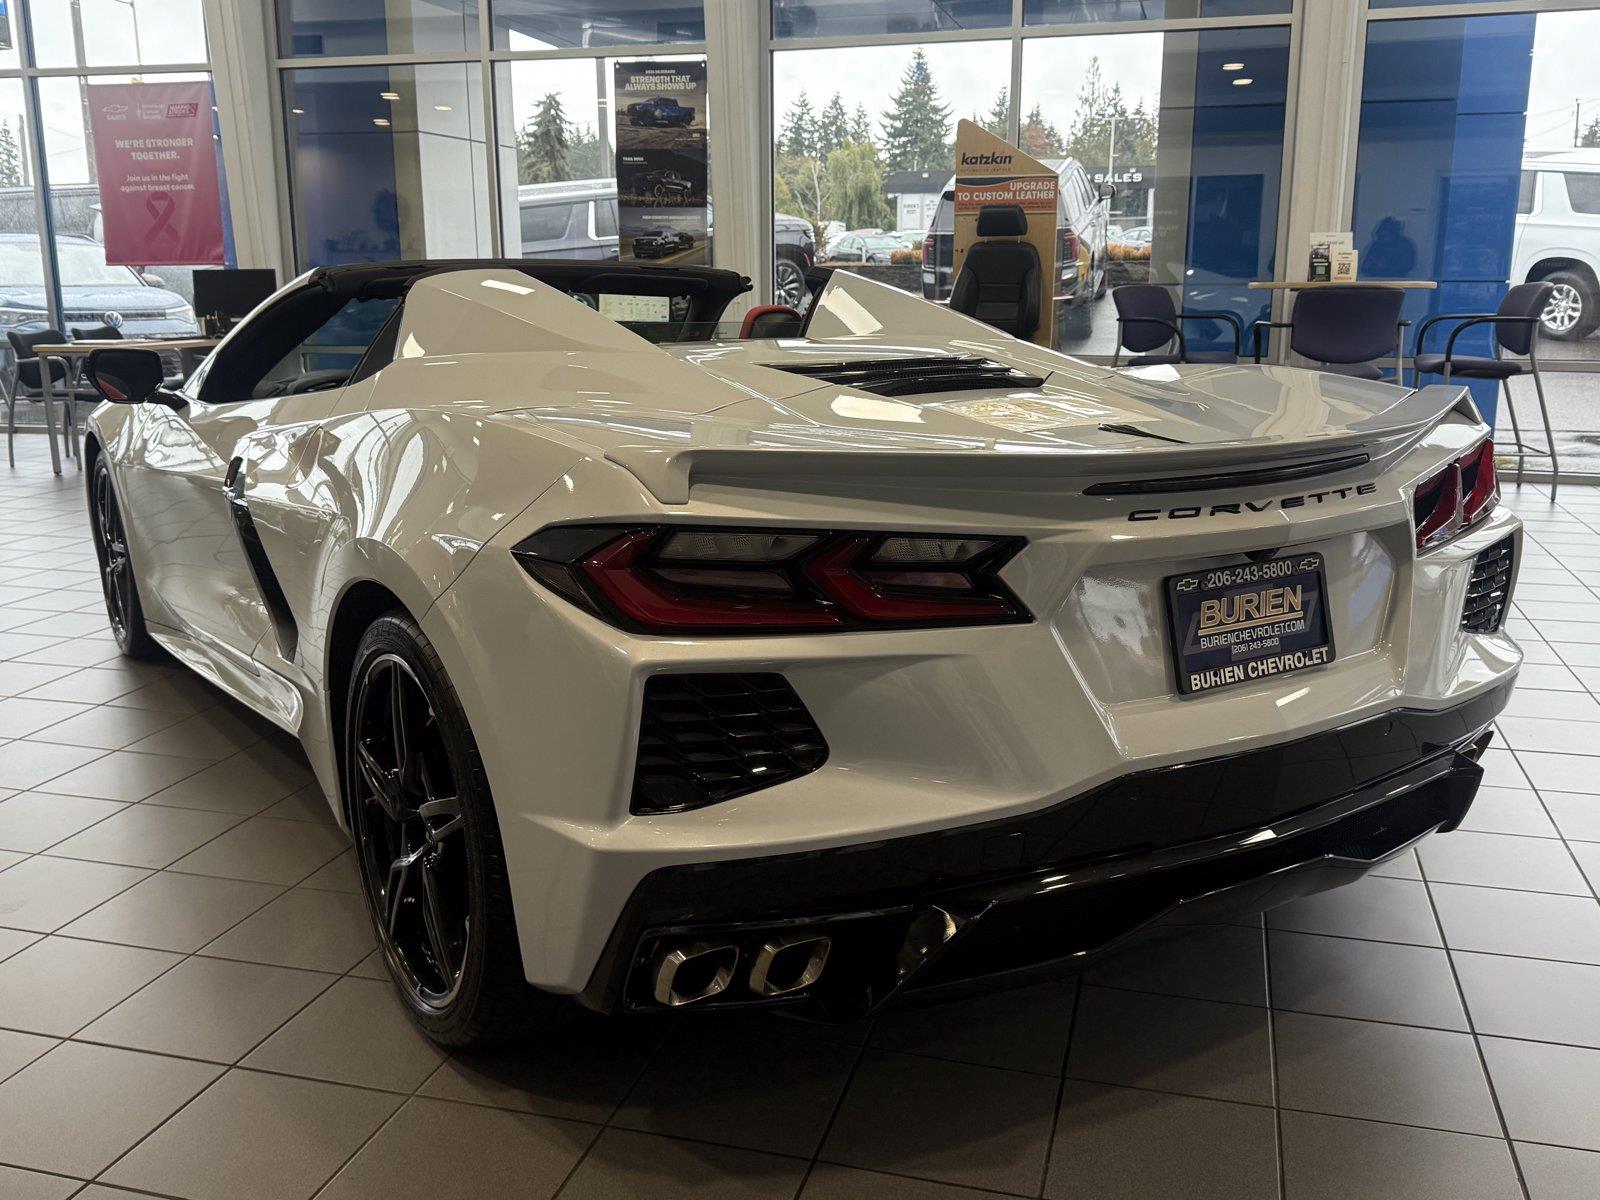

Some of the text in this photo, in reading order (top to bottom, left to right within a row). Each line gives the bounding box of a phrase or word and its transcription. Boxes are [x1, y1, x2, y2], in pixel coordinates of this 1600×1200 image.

[630, 75, 691, 83] STRENGTH THAT
[624, 83, 655, 91] ALWAYS
[656, 82, 685, 90] SHOWS
[115, 137, 194, 148] WE'RE STRONGER
[131, 151, 180, 160] TOGETHER.
[961, 150, 1013, 165] katzkin
[158, 173, 170, 181] the
[171, 173, 189, 182] fight
[1094, 173, 1143, 183] SALES
[120, 184, 147, 192] against
[1009, 181, 1055, 191] UPGRADE
[957, 190, 1055, 201] TO CUSTOM LEATHER
[1128, 482, 1377, 521] CORVETTE
[1207, 560, 1292, 588] 206-243-5800
[1200, 585, 1302, 628] BURIEN
[1200, 620, 1305, 649] BURIENCHEVROLET.COM
[1231, 637, 1280, 655] (206) 243-5800
[1190, 646, 1329, 691] BURIEN CHEVROLET
